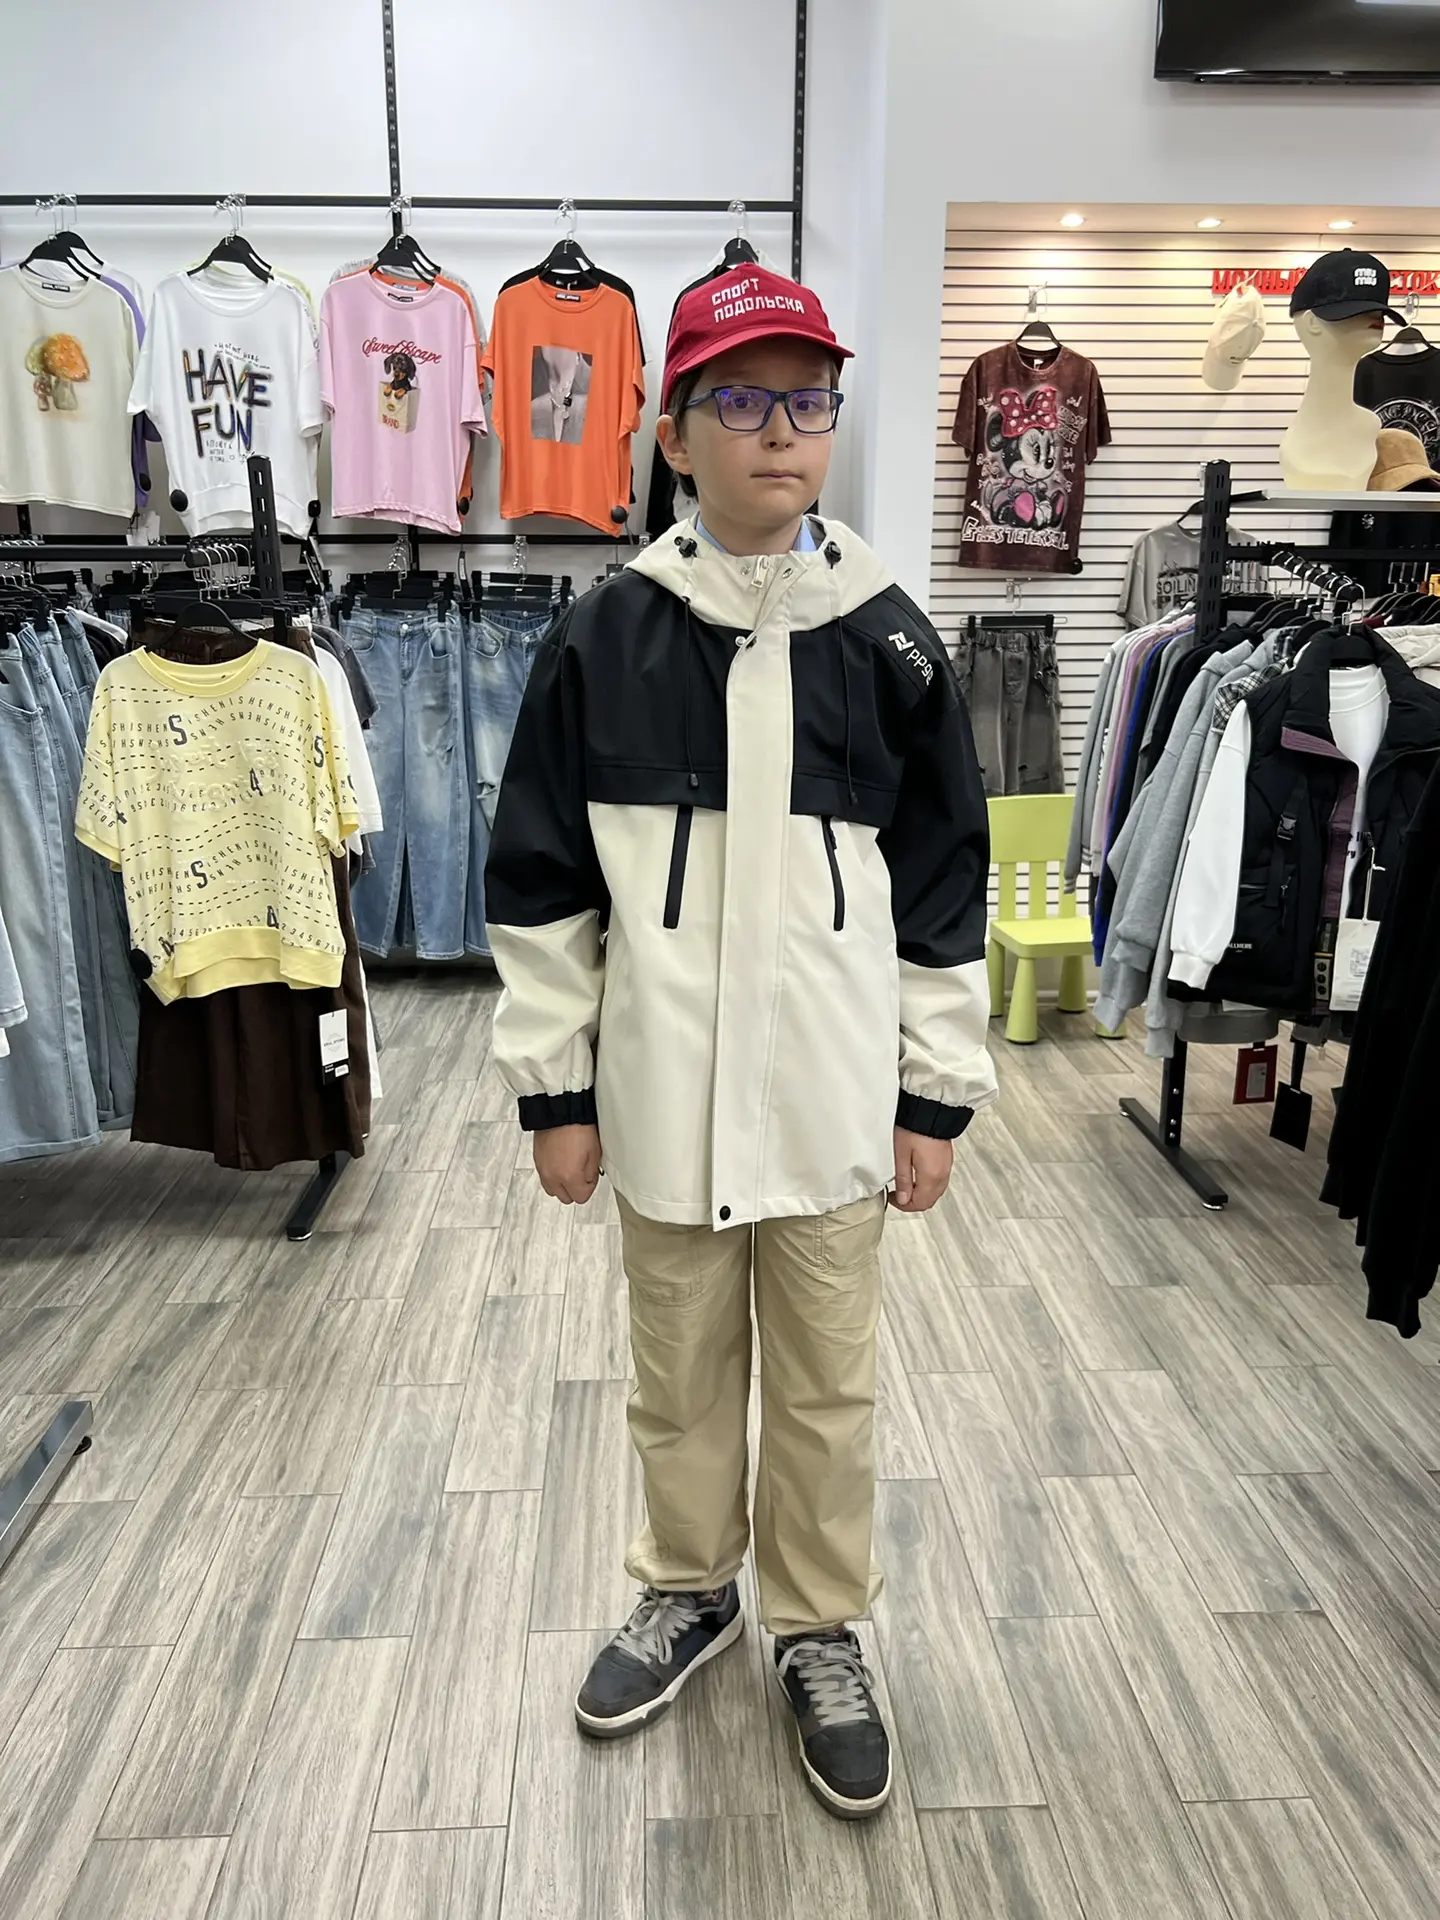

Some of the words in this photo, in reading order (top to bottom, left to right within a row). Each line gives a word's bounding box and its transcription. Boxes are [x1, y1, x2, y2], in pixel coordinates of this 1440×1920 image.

[711, 278, 759, 306] СПОРТ
[714, 296, 805, 323] ПОДОЛЬСКА
[183, 348, 274, 408] HAVE
[191, 403, 253, 458] FUN
[1157, 574, 1199, 595] SOILIN
